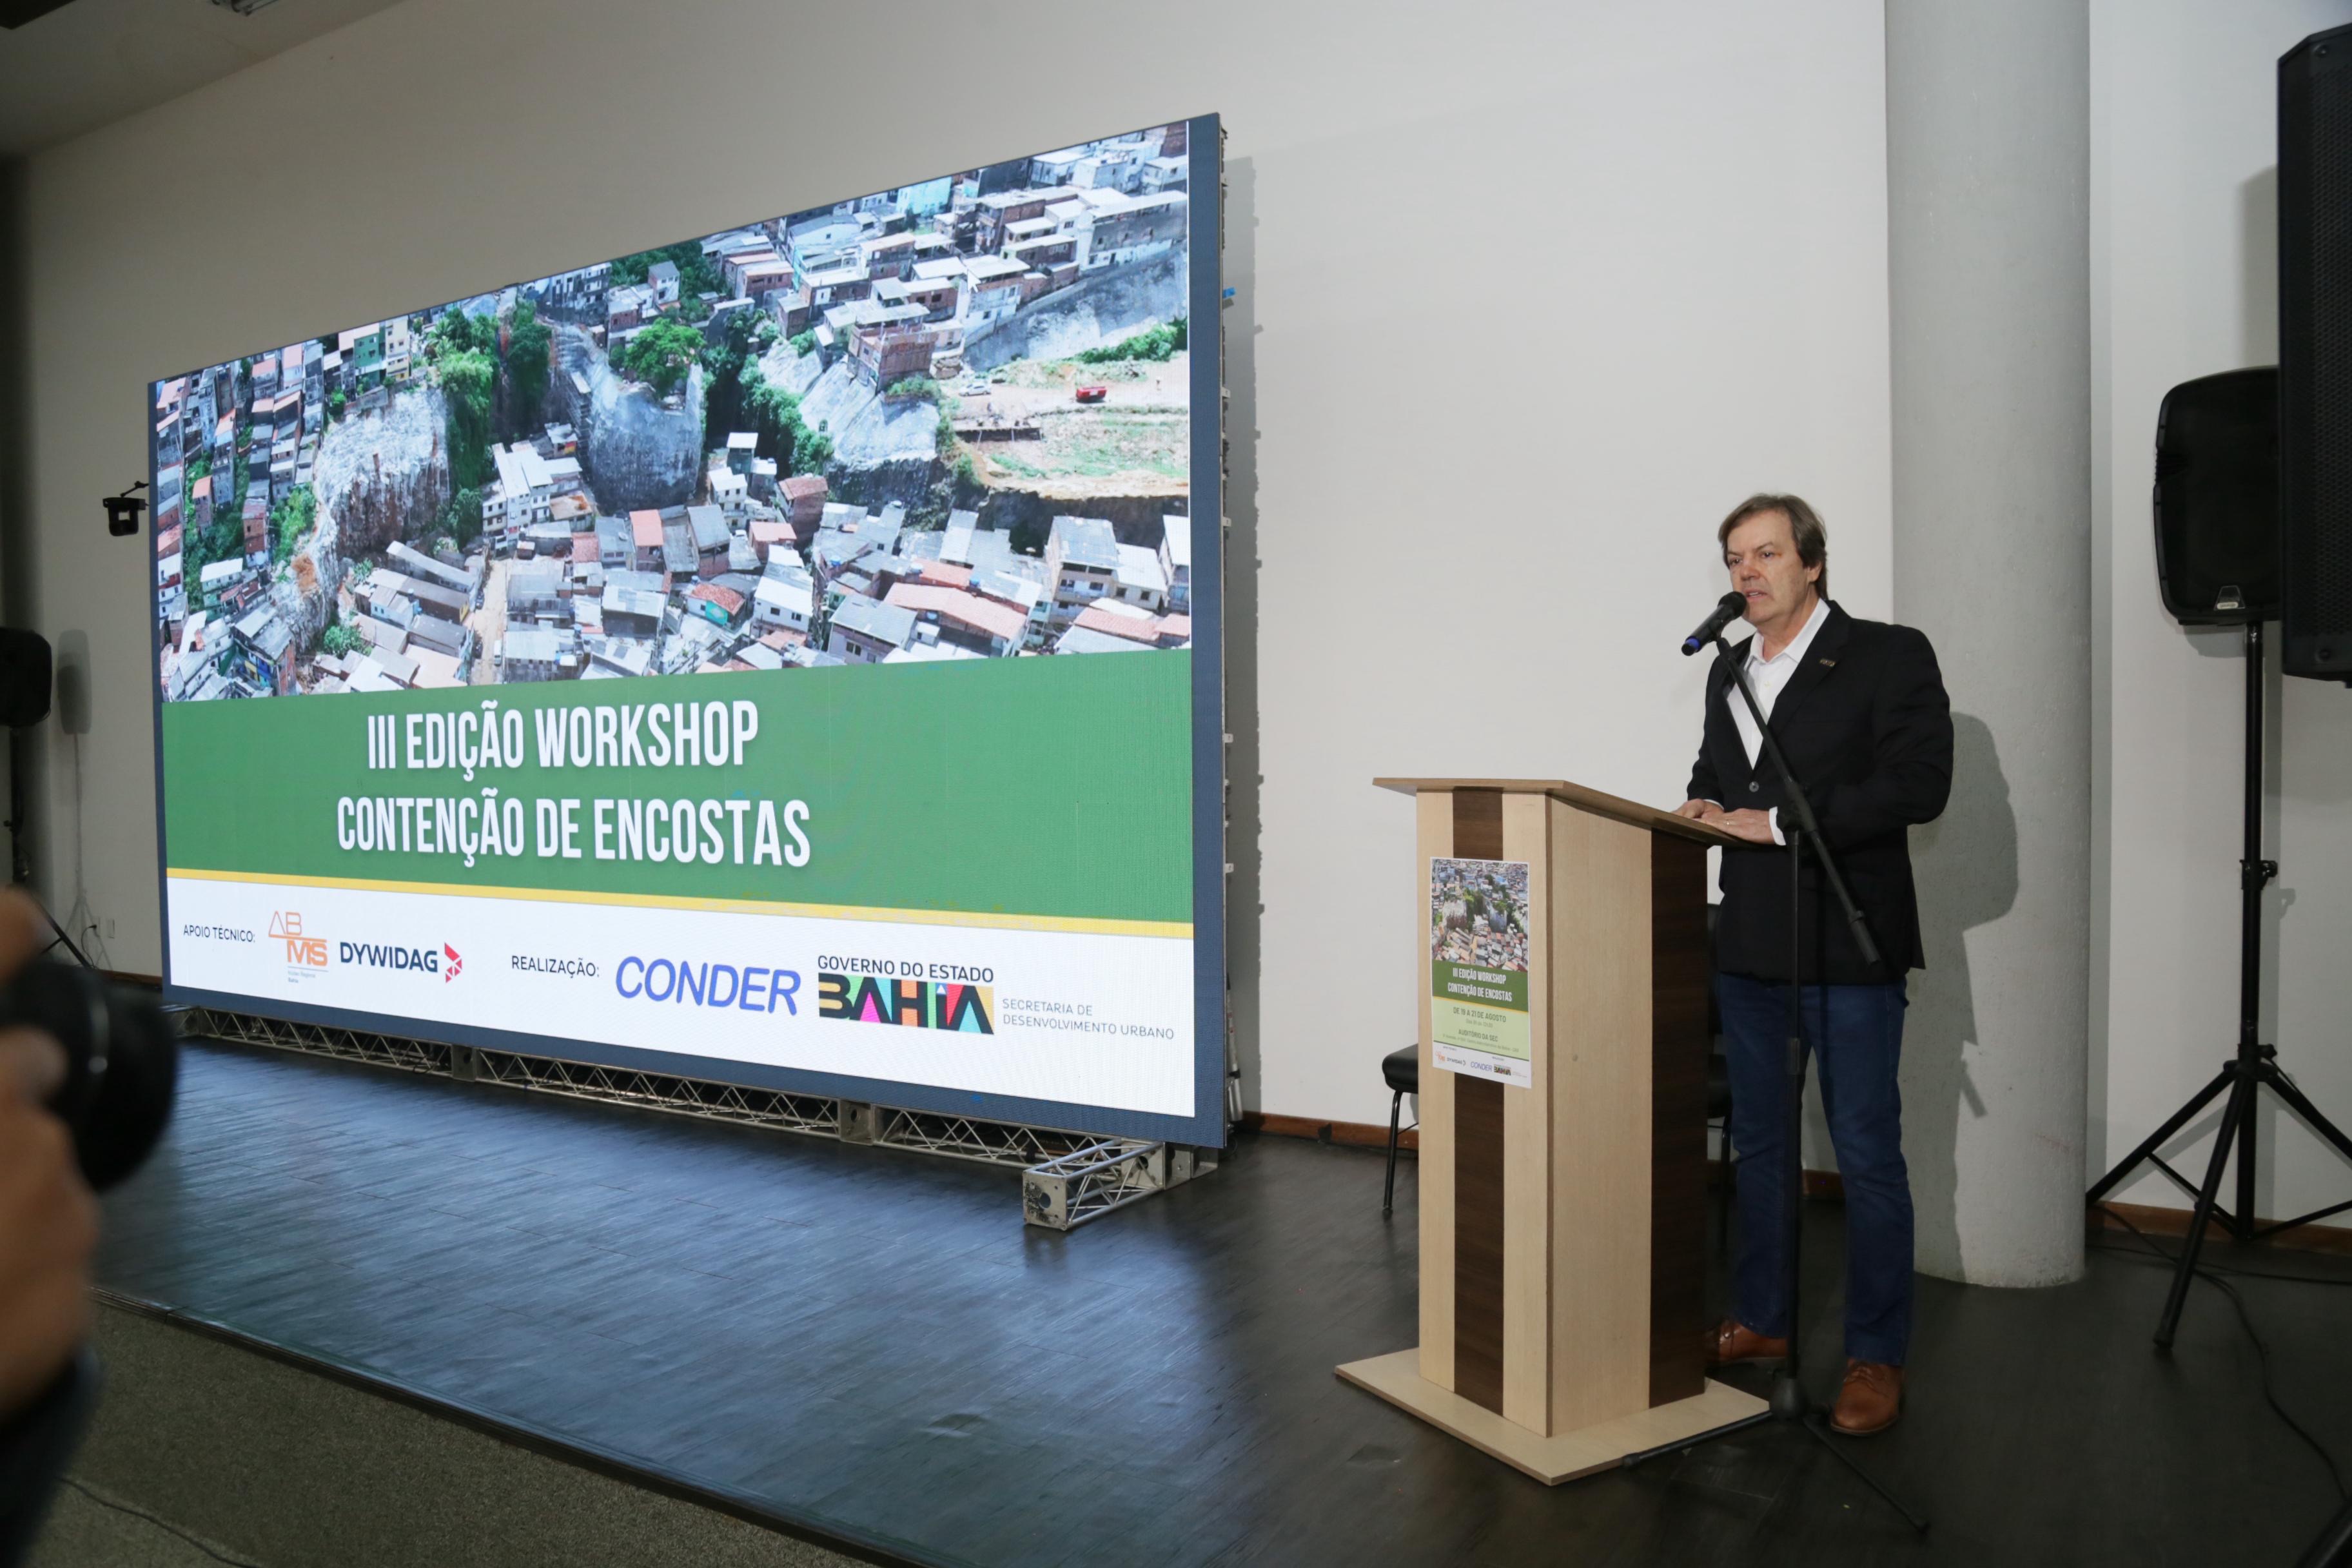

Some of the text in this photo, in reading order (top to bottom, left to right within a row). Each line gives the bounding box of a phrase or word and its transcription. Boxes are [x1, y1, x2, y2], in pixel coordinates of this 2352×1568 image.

[368, 700, 760, 781] III EDIÇÃO WORKSHOP
[337, 787, 811, 868] CONTENÇÃO DE ENCOSTAS
[183, 925, 256, 943] APOIO TÉCNICO:
[286, 939, 328, 967] MS
[339, 941, 438, 973] DYWIDAG
[511, 955, 600, 978] REALIZAÇÃO:
[818, 956, 994, 983] GOVERNO DO ESTADO
[1458, 968, 1476, 981] EDIÇÃO
[1477, 971, 1506, 985] WORKSHOP
[616, 956, 801, 1016] CONDER
[1447, 982, 1513, 1001] CONTENÇÃO DE ENCOSTAS
[818, 972, 995, 1035] BAHIA
[1003, 998, 1092, 1016] SECRETARIA DE
[1003, 1014, 1174, 1040] DESENVOLVIMENTO URBANO
[1485, 1013, 1507, 1023] AGOSTO
[1470, 1061, 1493, 1072] CONDER
